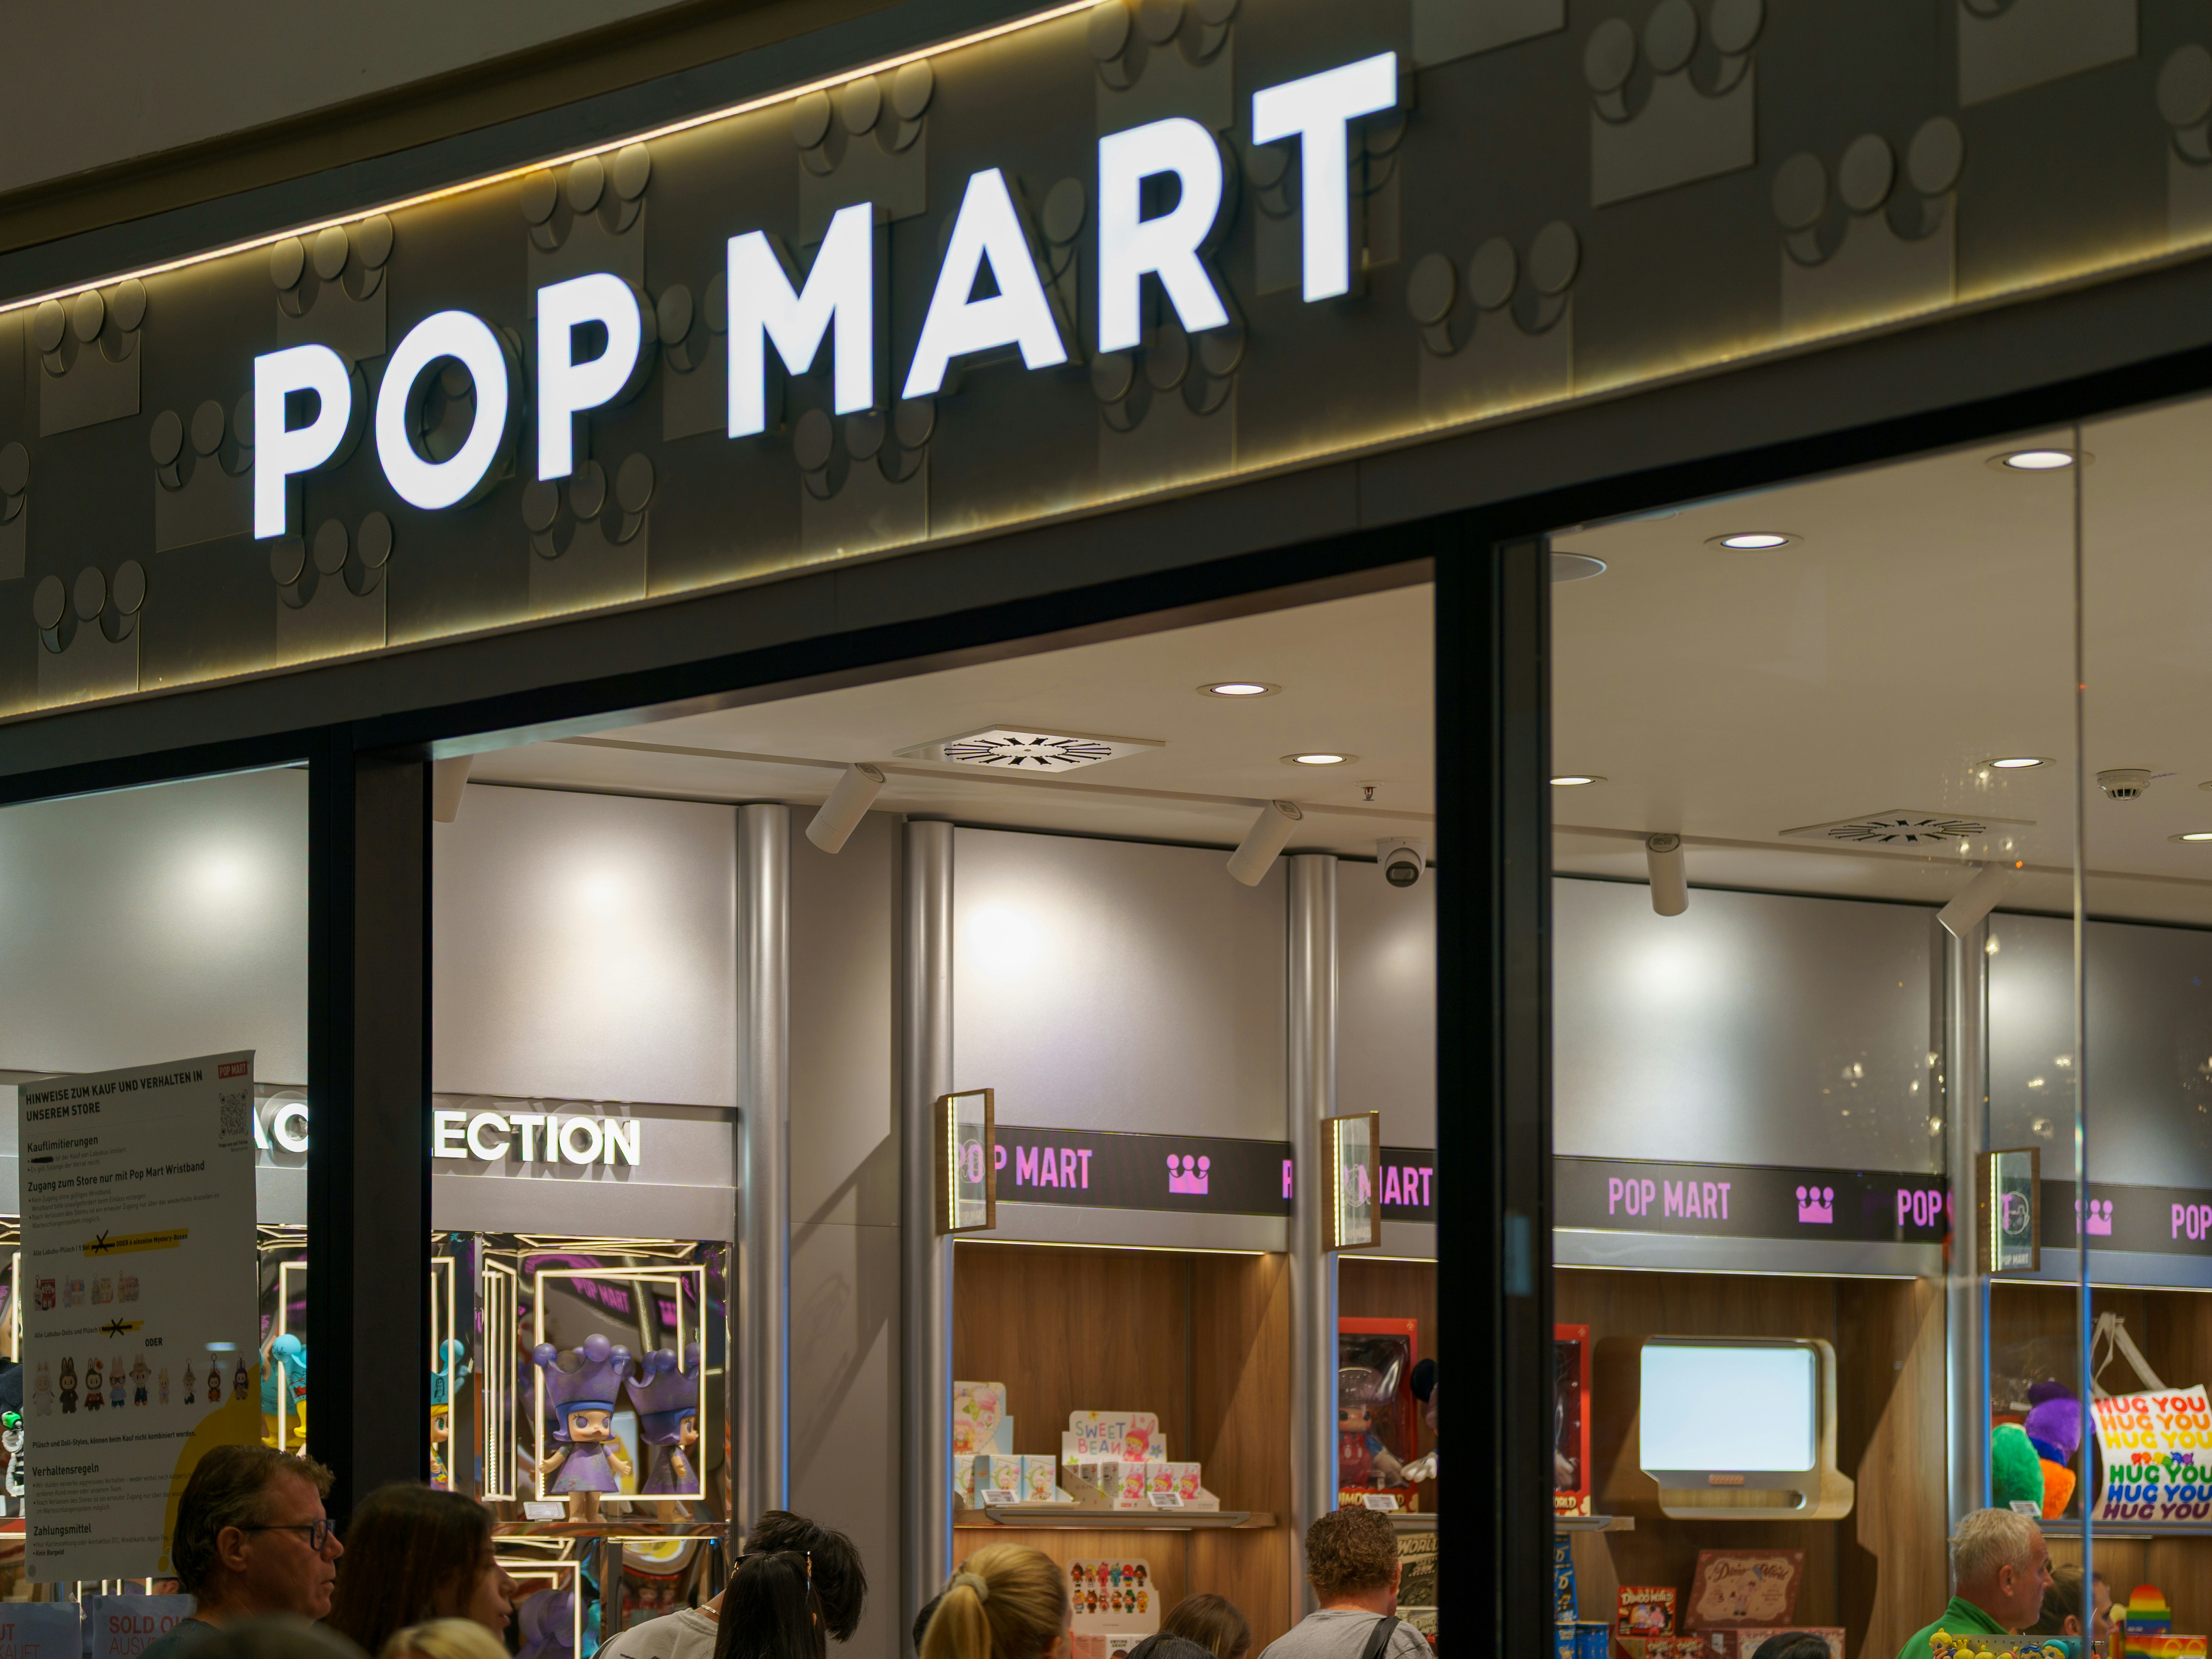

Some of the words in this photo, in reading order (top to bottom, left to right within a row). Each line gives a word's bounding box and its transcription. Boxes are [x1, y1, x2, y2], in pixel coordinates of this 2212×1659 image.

[253, 273, 641, 539] POP
[727, 51, 1397, 437] MART
[219, 1066, 230, 1077] POP
[231, 1063, 246, 1075] MART
[26, 1089, 69, 1105] HINWEISE
[71, 1086, 90, 1099] ZUM
[92, 1083, 116, 1096] KAUF
[119, 1080, 138, 1092] UND
[140, 1072, 191, 1089] VERHALTEN
[193, 1070, 203, 1081] IN
[26, 1106, 70, 1121] UNSEREM
[72, 1102, 100, 1115] STORE
[27, 1137, 98, 1152] Kauflimitierungen
[432, 1110, 640, 1166] ECTION
[28, 1181, 56, 1192] Zugang
[58, 1179, 74, 1188] zum
[76, 1176, 97, 1186] Store
[100, 1175, 113, 1183] nur
[115, 1171, 127, 1181] mit
[130, 1170, 144, 1180] Pop
[146, 1167, 164, 1177] Mart
[166, 1161, 205, 1175] Wristband
[1016, 1146, 1092, 1189] MART
[32, 1203, 53, 1212] Wristband
[64, 1198, 97, 1207] unaufgefordert
[167, 1195, 192, 1204] wiederholte
[1609, 1177, 1655, 1217] POP
[1664, 1180, 1730, 1220] MART
[1897, 1189, 1942, 1227] POP
[32, 1219, 81, 1229] Warteschlangensystem
[2172, 1204, 2212, 1240] POP
[42, 1245, 75, 1255] Labubu-Plüsch
[154, 1234, 188, 1244] Mystery-Boxen
[44, 1329, 72, 1337] Labubu-Dolls
[145, 1337, 163, 1346] ODER
[2095, 1397, 2149, 1413] HUG
[2151, 1396, 2206, 1413] YOU
[1075, 1421, 1126, 1439] SWEET
[2100, 1414, 2154, 1431] HUG
[2155, 1413, 2210, 1430] YOU
[1078, 1438, 1121, 1455] BEAN
[2104, 1431, 2157, 1449] HUG
[2160, 1431, 2212, 1449] YOU
[32, 1463, 99, 1477] Verhaltensregeln
[2110, 1465, 2159, 1483] HUG
[2164, 1465, 2212, 1483] YOU
[1554, 1495, 1577, 1510] ORLD
[2108, 1485, 2158, 1503] HUG
[2165, 1485, 2212, 1502] YOU
[2103, 1503, 2155, 1520] HUG
[2161, 1503, 2210, 1520] YOU
[34, 1523, 91, 1536] Zahlungsmittel
[109, 1615, 154, 1634] SOLD
